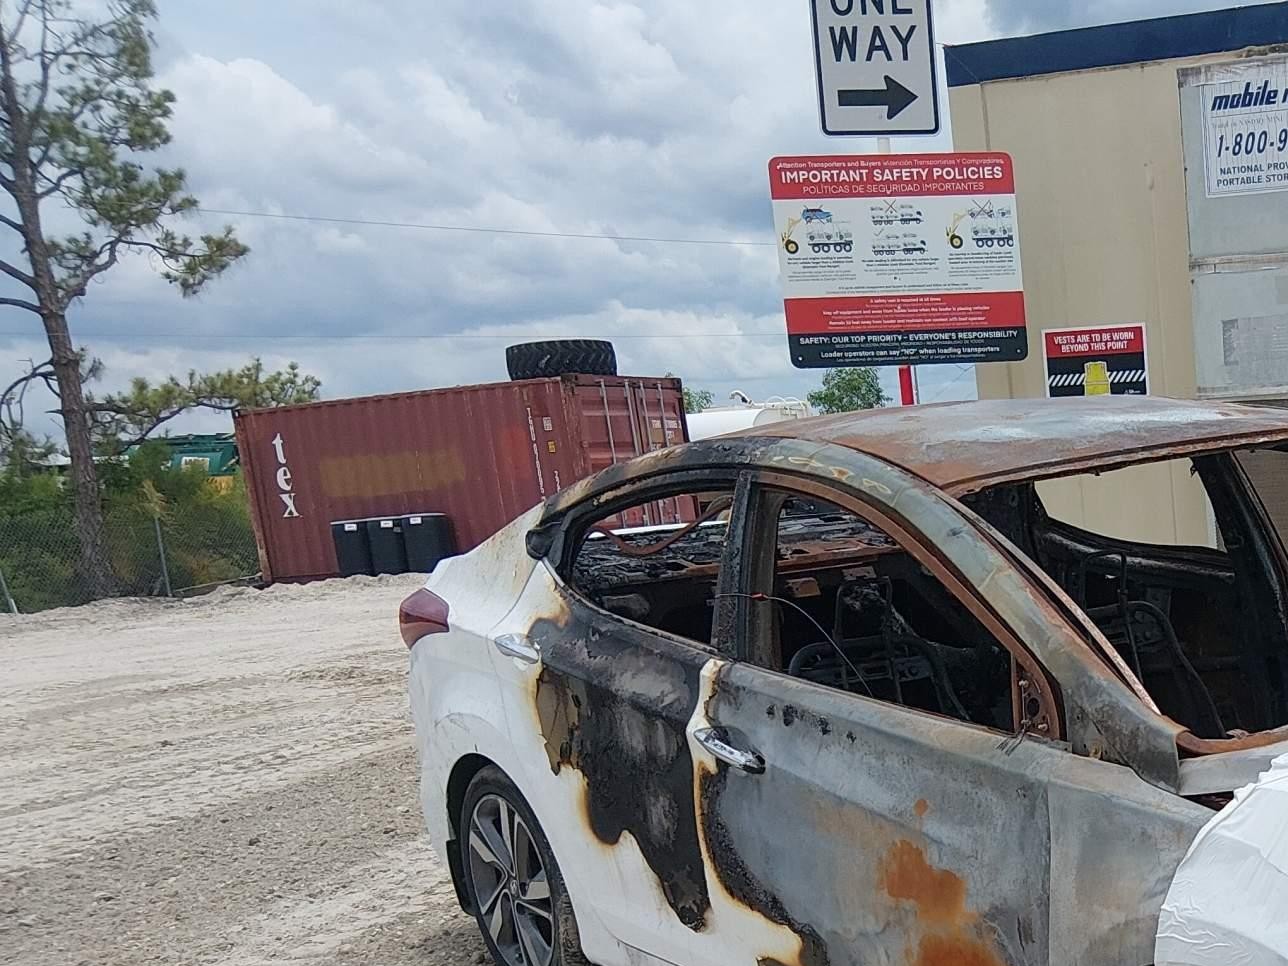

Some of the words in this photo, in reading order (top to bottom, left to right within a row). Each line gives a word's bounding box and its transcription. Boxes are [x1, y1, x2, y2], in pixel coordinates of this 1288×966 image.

[828, 25, 917, 62] WAY
[1211, 80, 1279, 111] mobile
[808, 161, 846, 169] Transporters
[860, 160, 881, 168] Buyers
[1219, 163, 1265, 176] NATIONAL
[781, 169, 868, 184] IMPORTANT
[873, 167, 929, 182] SAFETY
[933, 166, 1003, 180] POLICIES
[1216, 175, 1263, 187] PORTABLE
[852, 184, 865, 193] DE
[866, 182, 920, 193] SEGURIDAD
[922, 181, 984, 192] IMPORTANTES
[799, 337, 831, 345] SAFETY:
[831, 336, 850, 344] OUR
[850, 335, 866, 343] TOP
[867, 334, 902, 343] PRIORITY
[957, 330, 1018, 339] RESPONSIBILITY
[1053, 335, 1075, 345] VESTS
[1076, 334, 1090, 343] ARE
[1091, 333, 1101, 342] TO
[1102, 332, 1111, 341] BE
[1112, 331, 1135, 341] WORN
[821, 350, 843, 358] Loader
[844, 350, 875, 358] operators
[938, 346, 961, 354] loading
[962, 346, 1000, 354] transporters
[1061, 343, 1089, 353] BEYOND
[1090, 342, 1105, 351] THIS
[1107, 340, 1128, 350] POINT
[272, 433, 302, 518] tex
